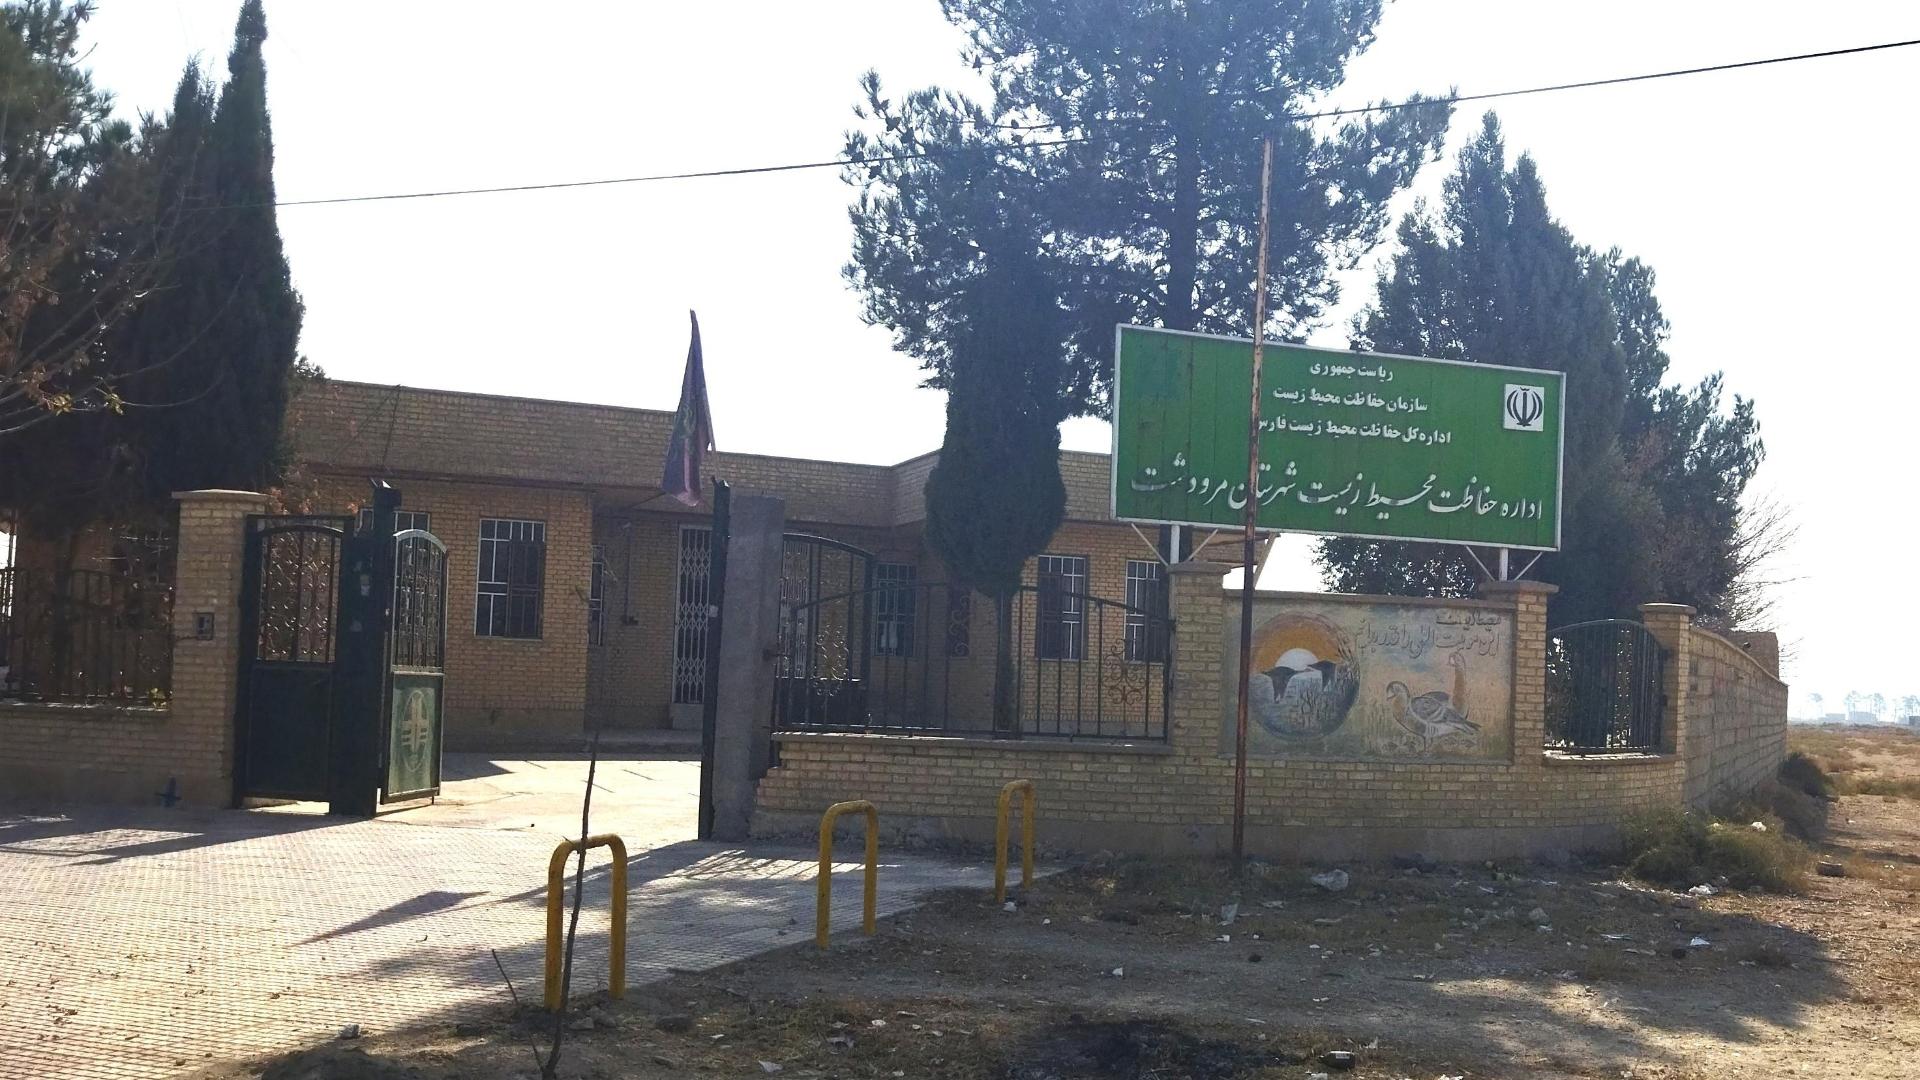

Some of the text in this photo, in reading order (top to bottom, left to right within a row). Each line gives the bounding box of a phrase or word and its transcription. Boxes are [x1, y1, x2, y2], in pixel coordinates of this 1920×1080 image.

[1310, 362, 1393, 382] ریاست جمهوری
[1273, 387, 1428, 413] سازمان حفاظت محیط زیست
[1289, 419, 1322, 436] زیست
[1325, 420, 1357, 438] محیط
[1359, 422, 1402, 438] حفاظت
[1131, 452, 1542, 520] اداره حفاظت محیط زیست شهرستان مرودشت
